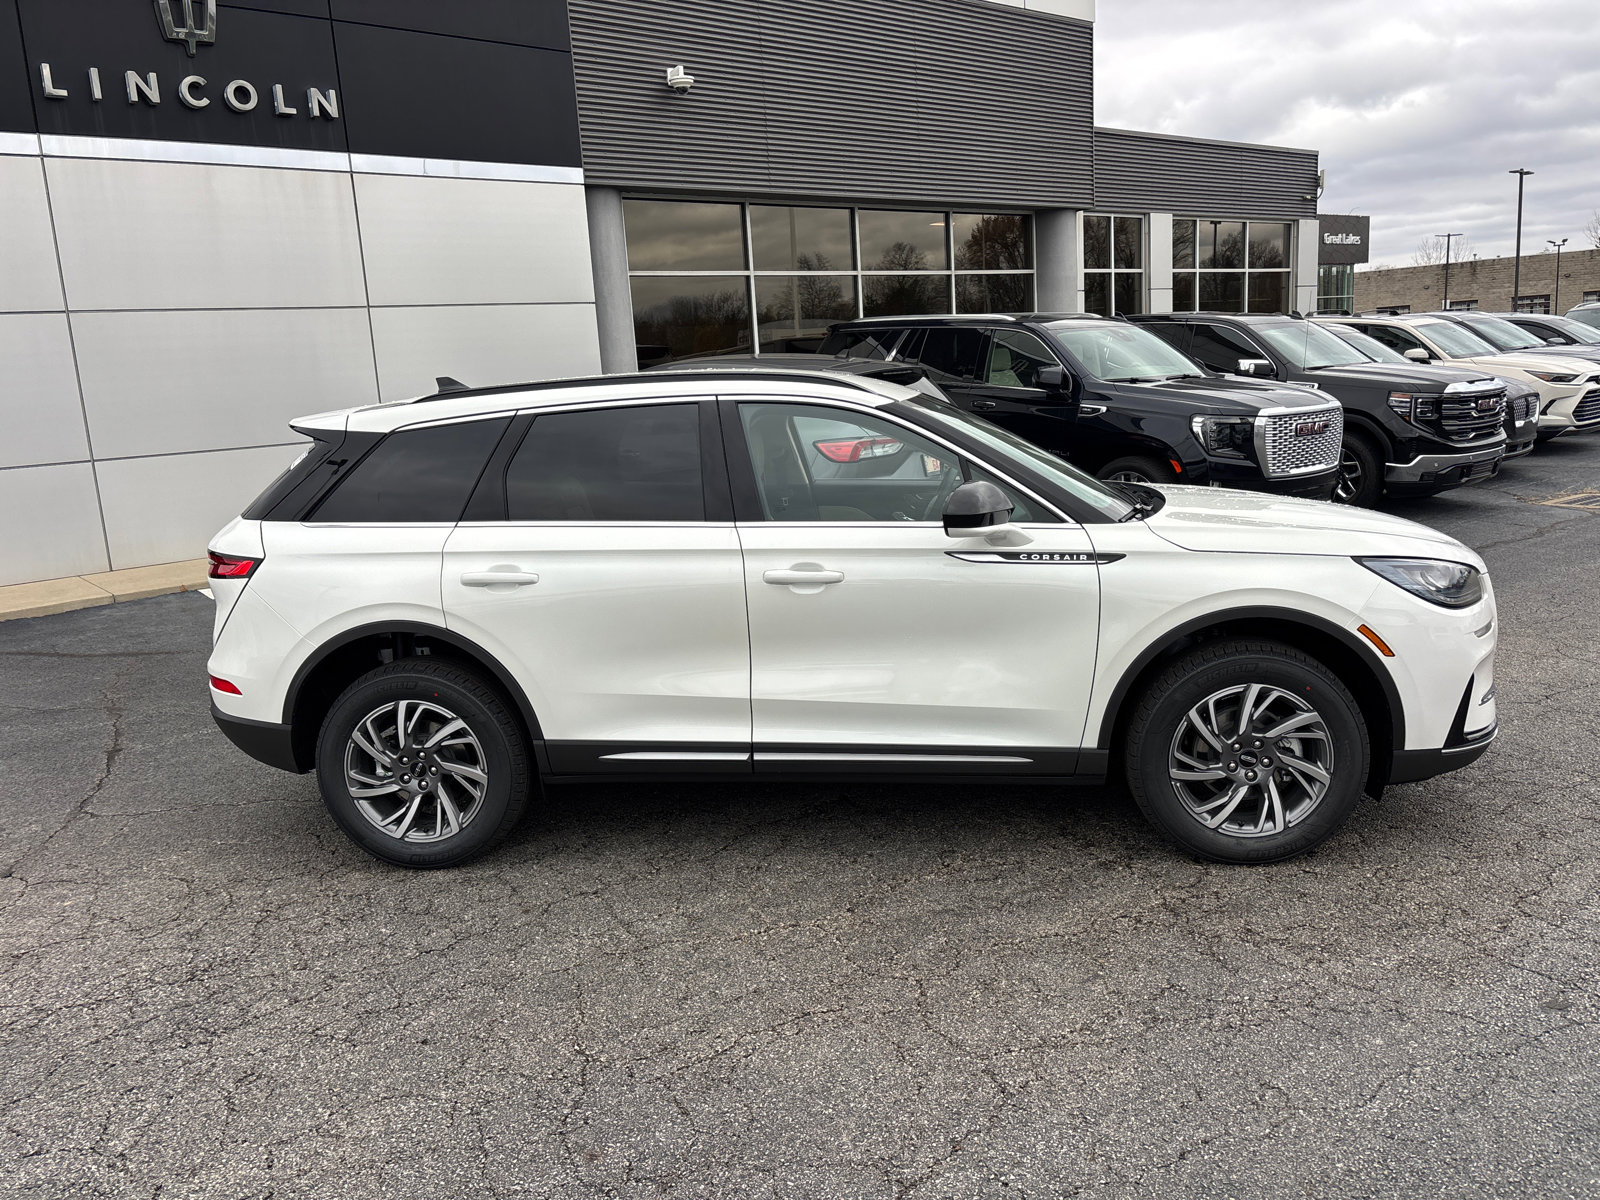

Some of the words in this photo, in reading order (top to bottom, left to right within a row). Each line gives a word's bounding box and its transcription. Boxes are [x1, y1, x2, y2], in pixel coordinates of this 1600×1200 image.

[40, 62, 339, 119] LINCOLN
[1323, 232, 1342, 244] Great
[1342, 233, 1361, 245] Lakes
[1297, 421, 1330, 436] GMC
[1019, 553, 1088, 561] CORSAIR
